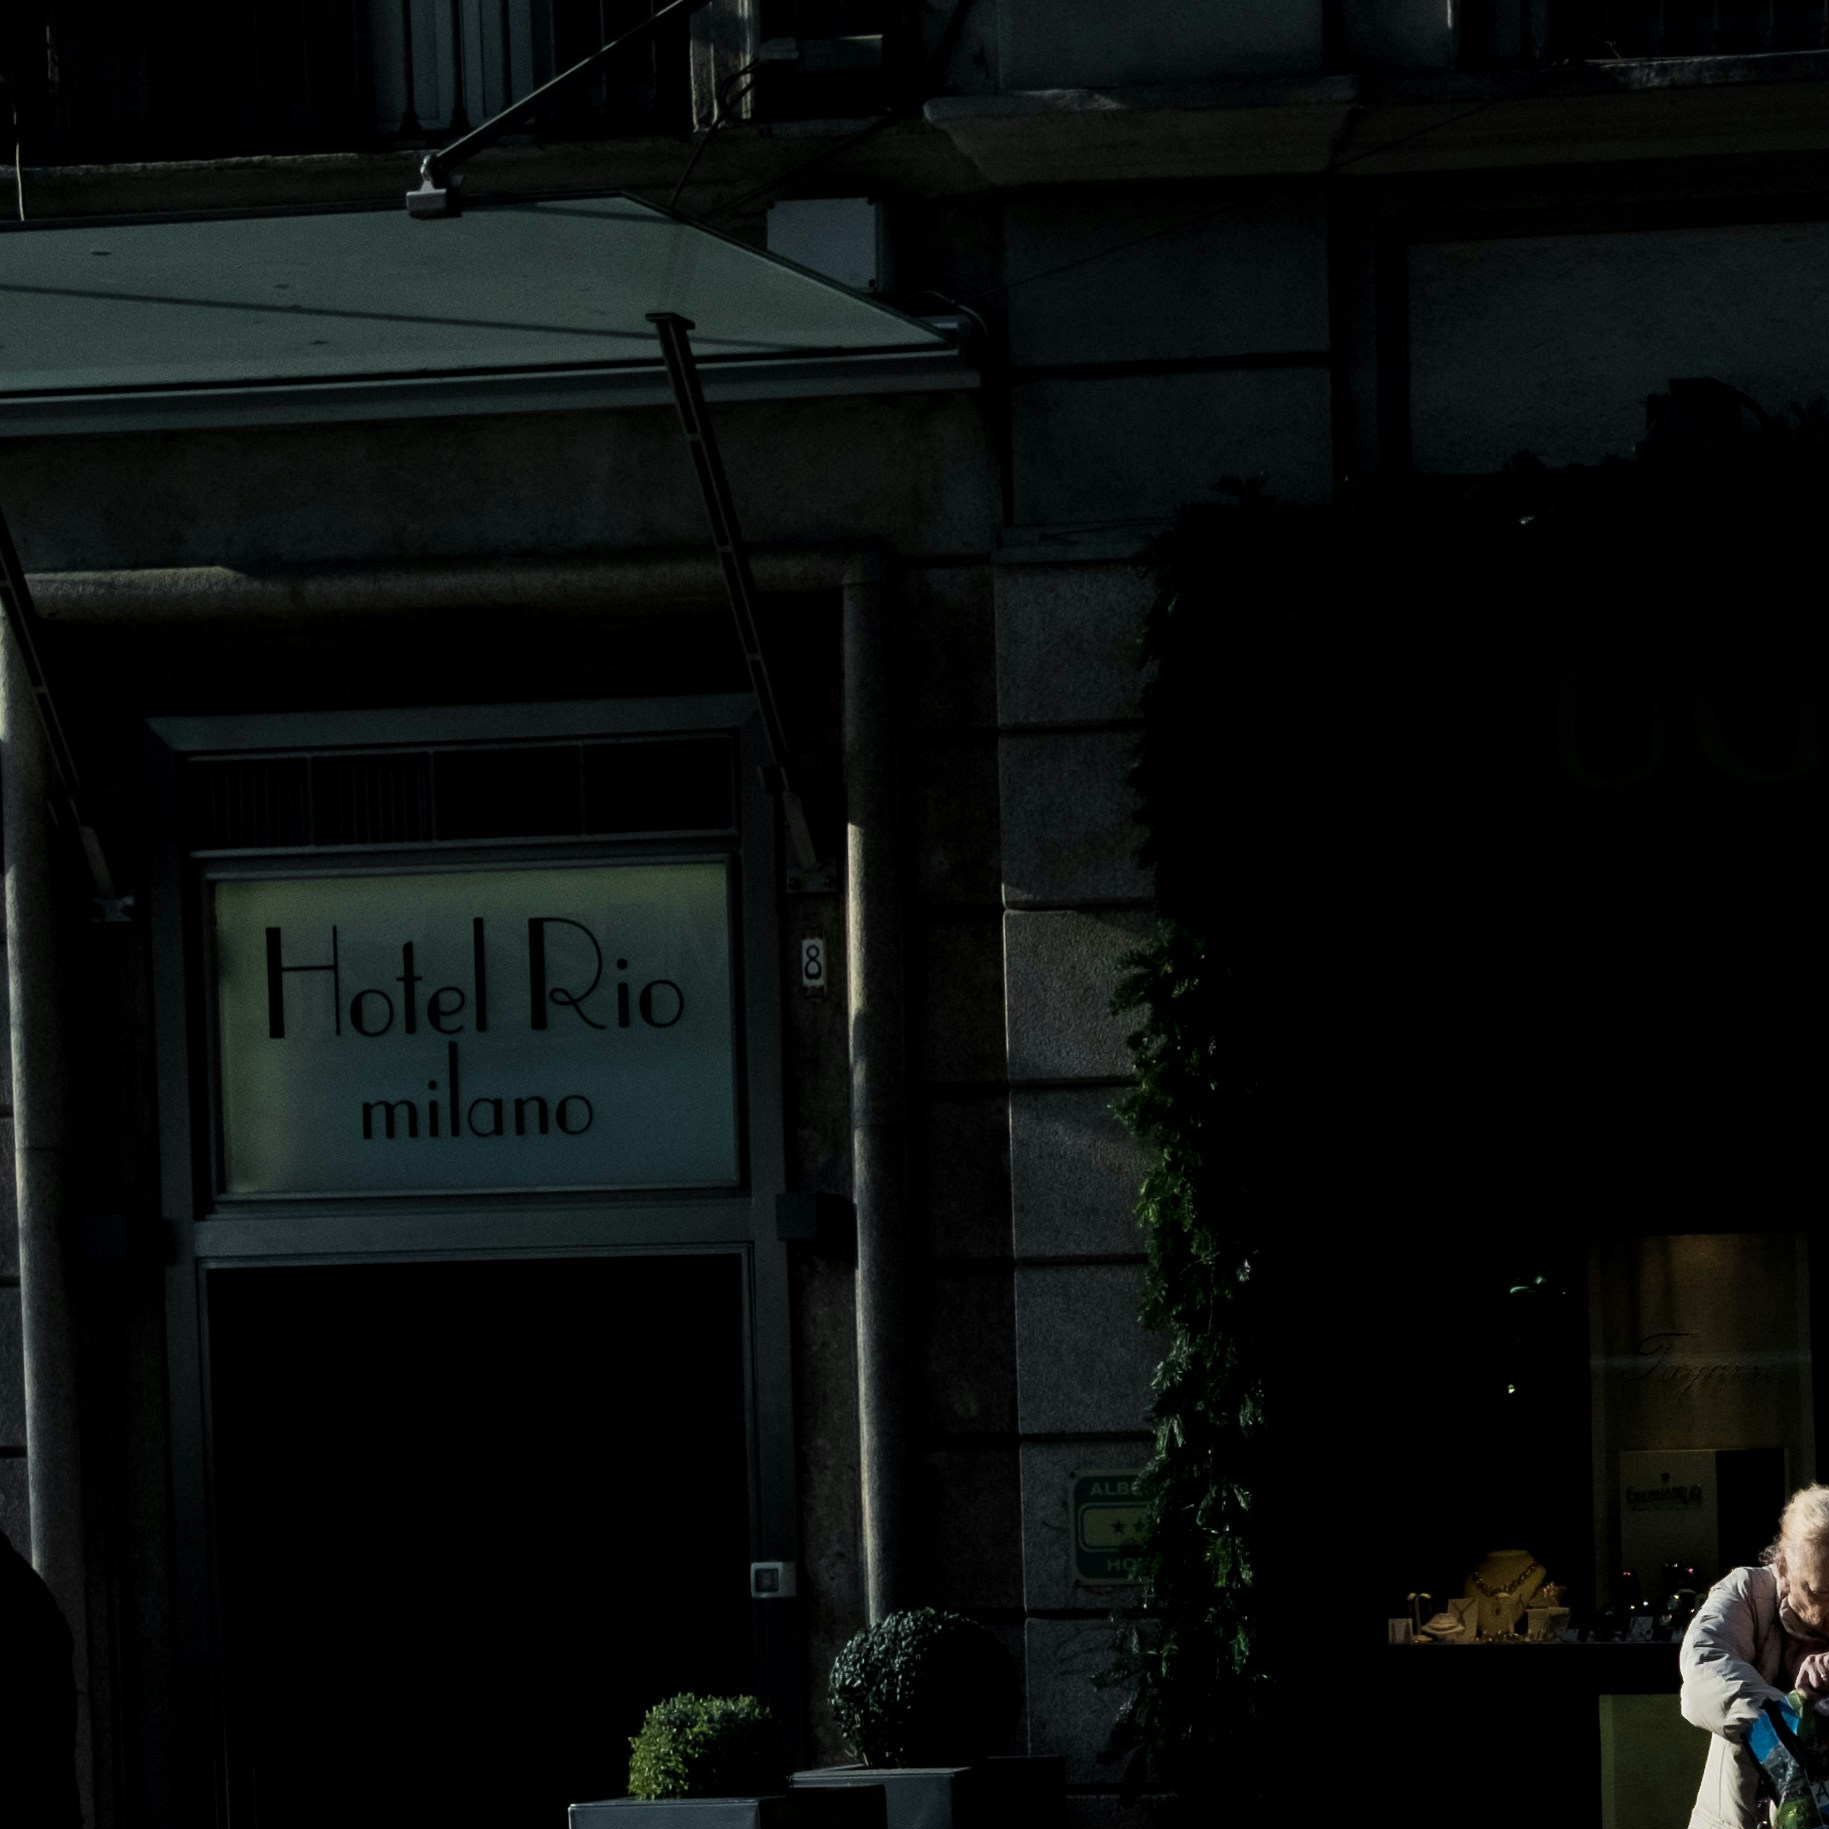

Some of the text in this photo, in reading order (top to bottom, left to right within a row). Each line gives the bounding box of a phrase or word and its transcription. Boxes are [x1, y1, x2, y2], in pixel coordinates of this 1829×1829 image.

[265, 917, 685, 1039] Hotel Rio
[804, 944, 822, 980] 8
[362, 1041, 594, 1140] milano
